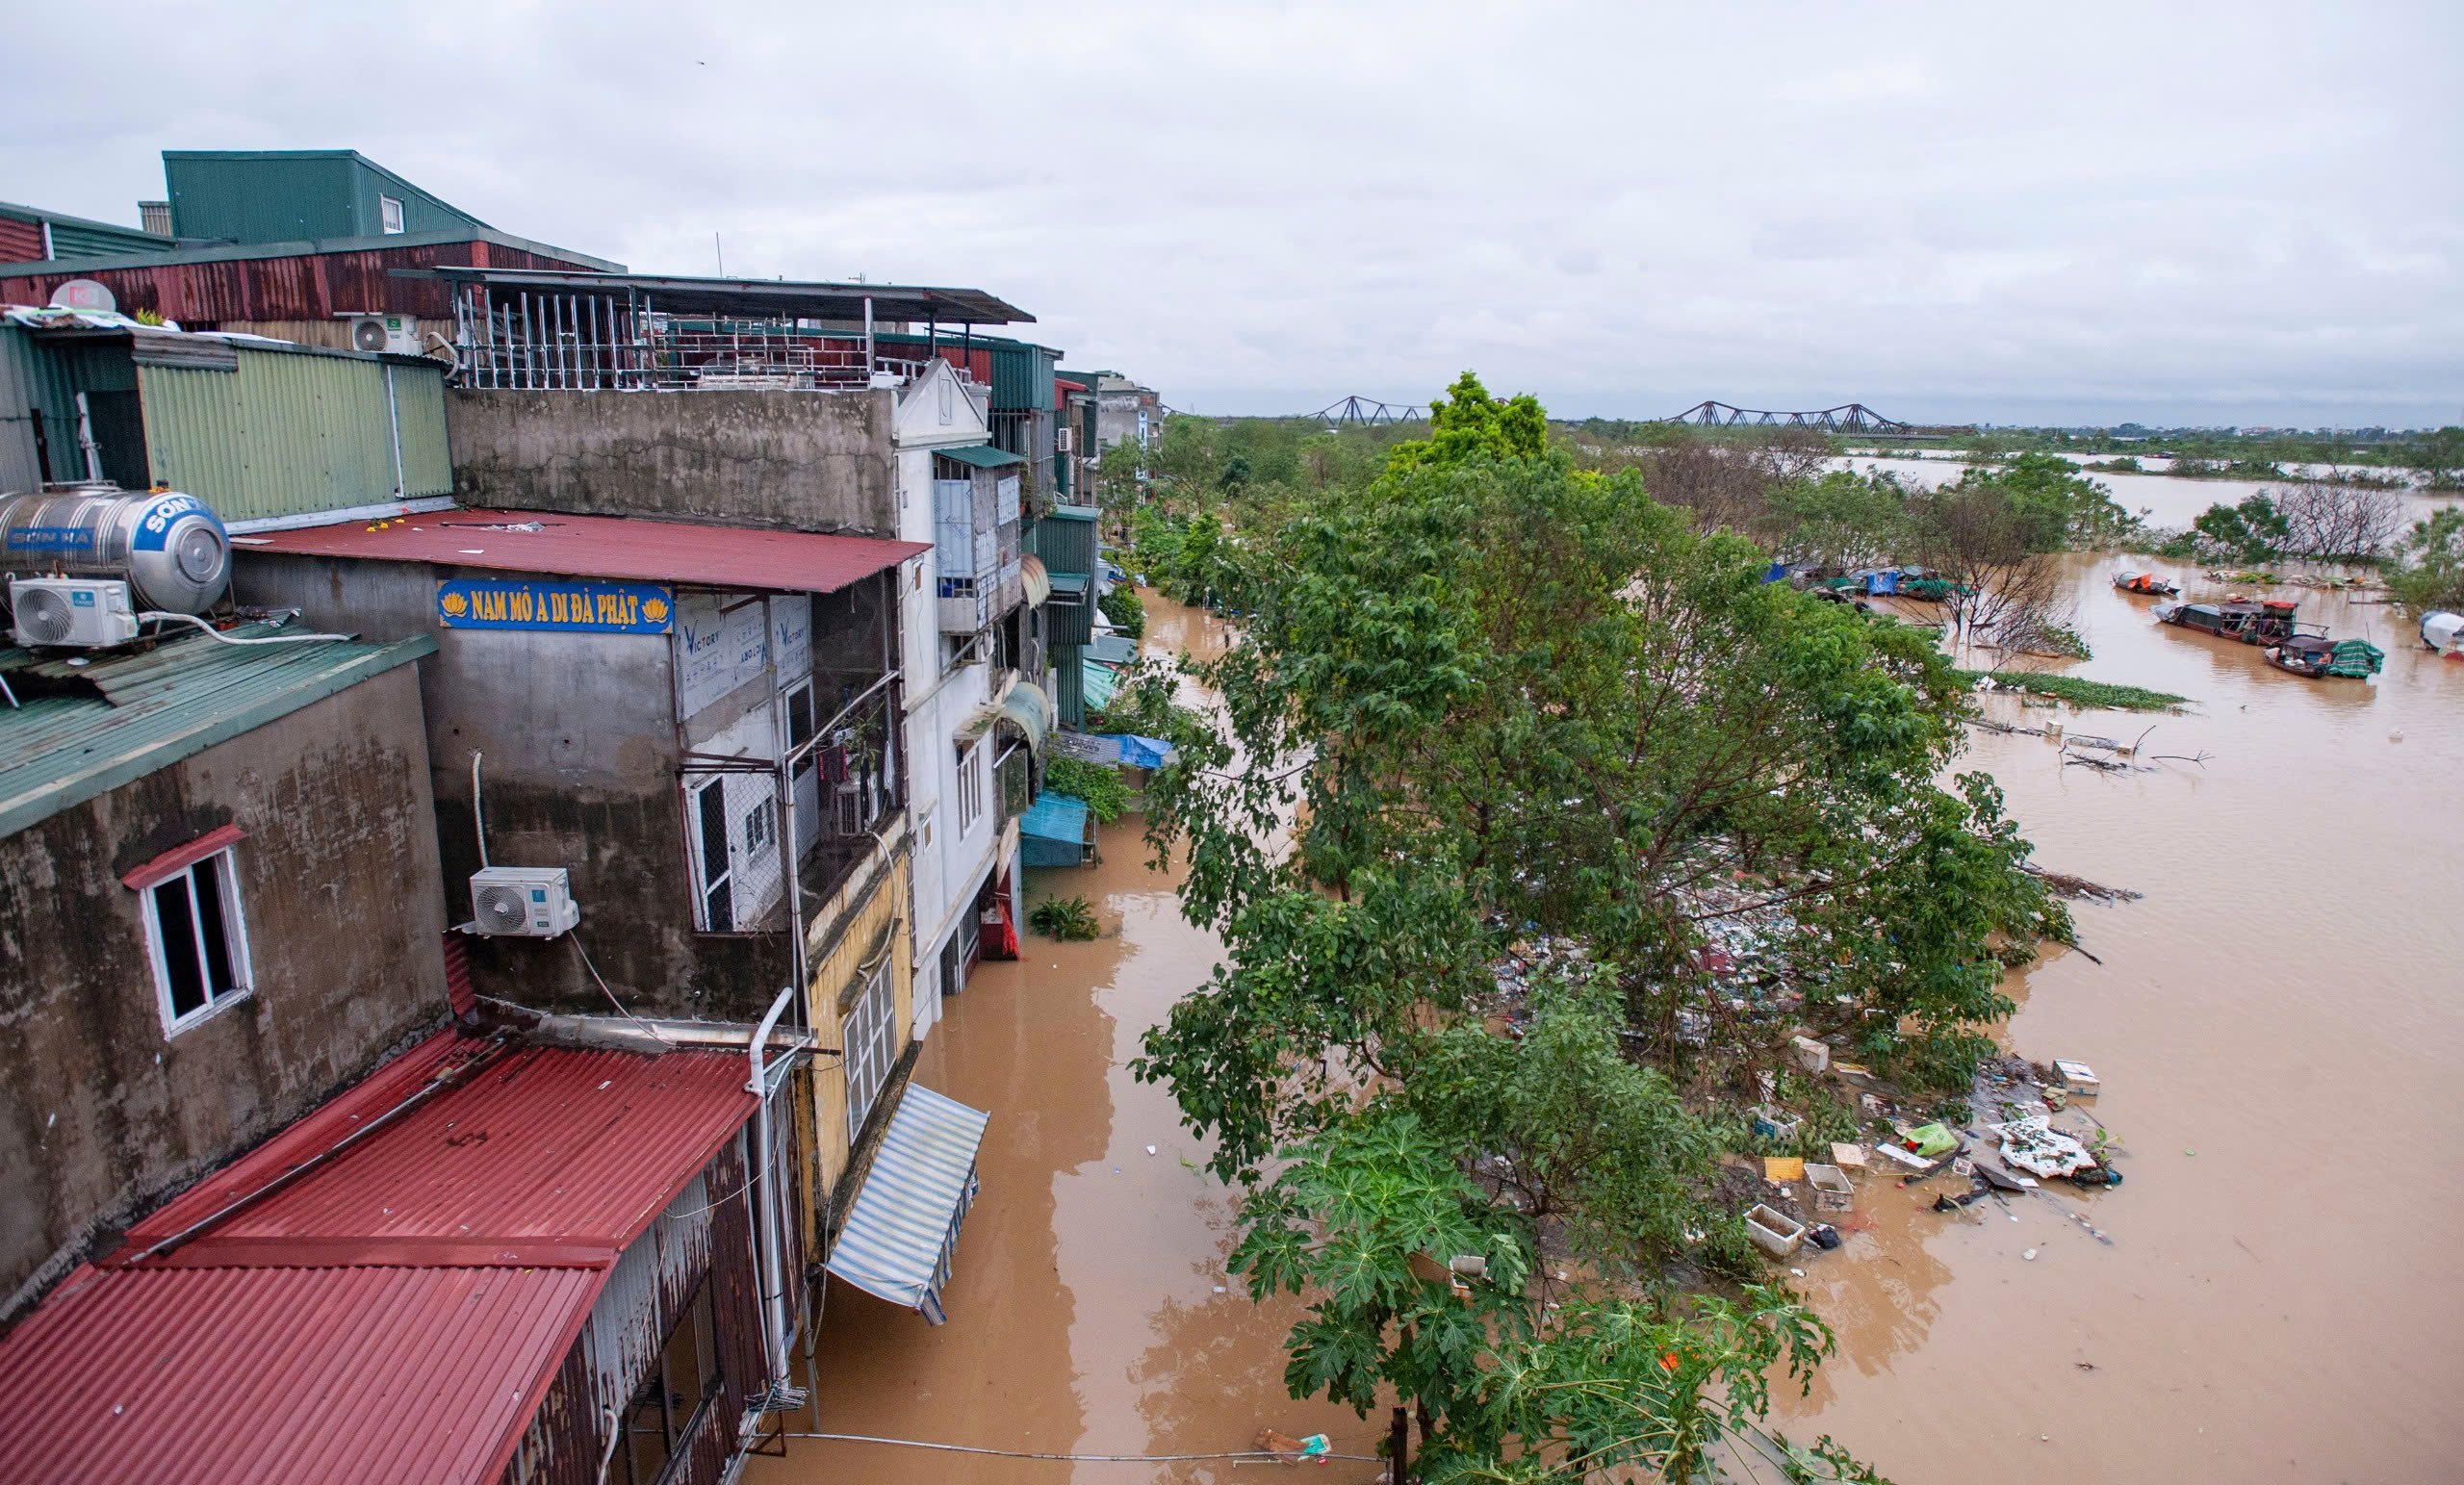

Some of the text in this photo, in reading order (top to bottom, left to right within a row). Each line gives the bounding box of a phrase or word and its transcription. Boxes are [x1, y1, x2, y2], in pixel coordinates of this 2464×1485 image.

[470, 590, 507, 621] NAM
[508, 584, 533, 622] MÔ
[536, 592, 550, 623] A
[550, 593, 569, 624] DI
[596, 587, 639, 631] PHẬT
